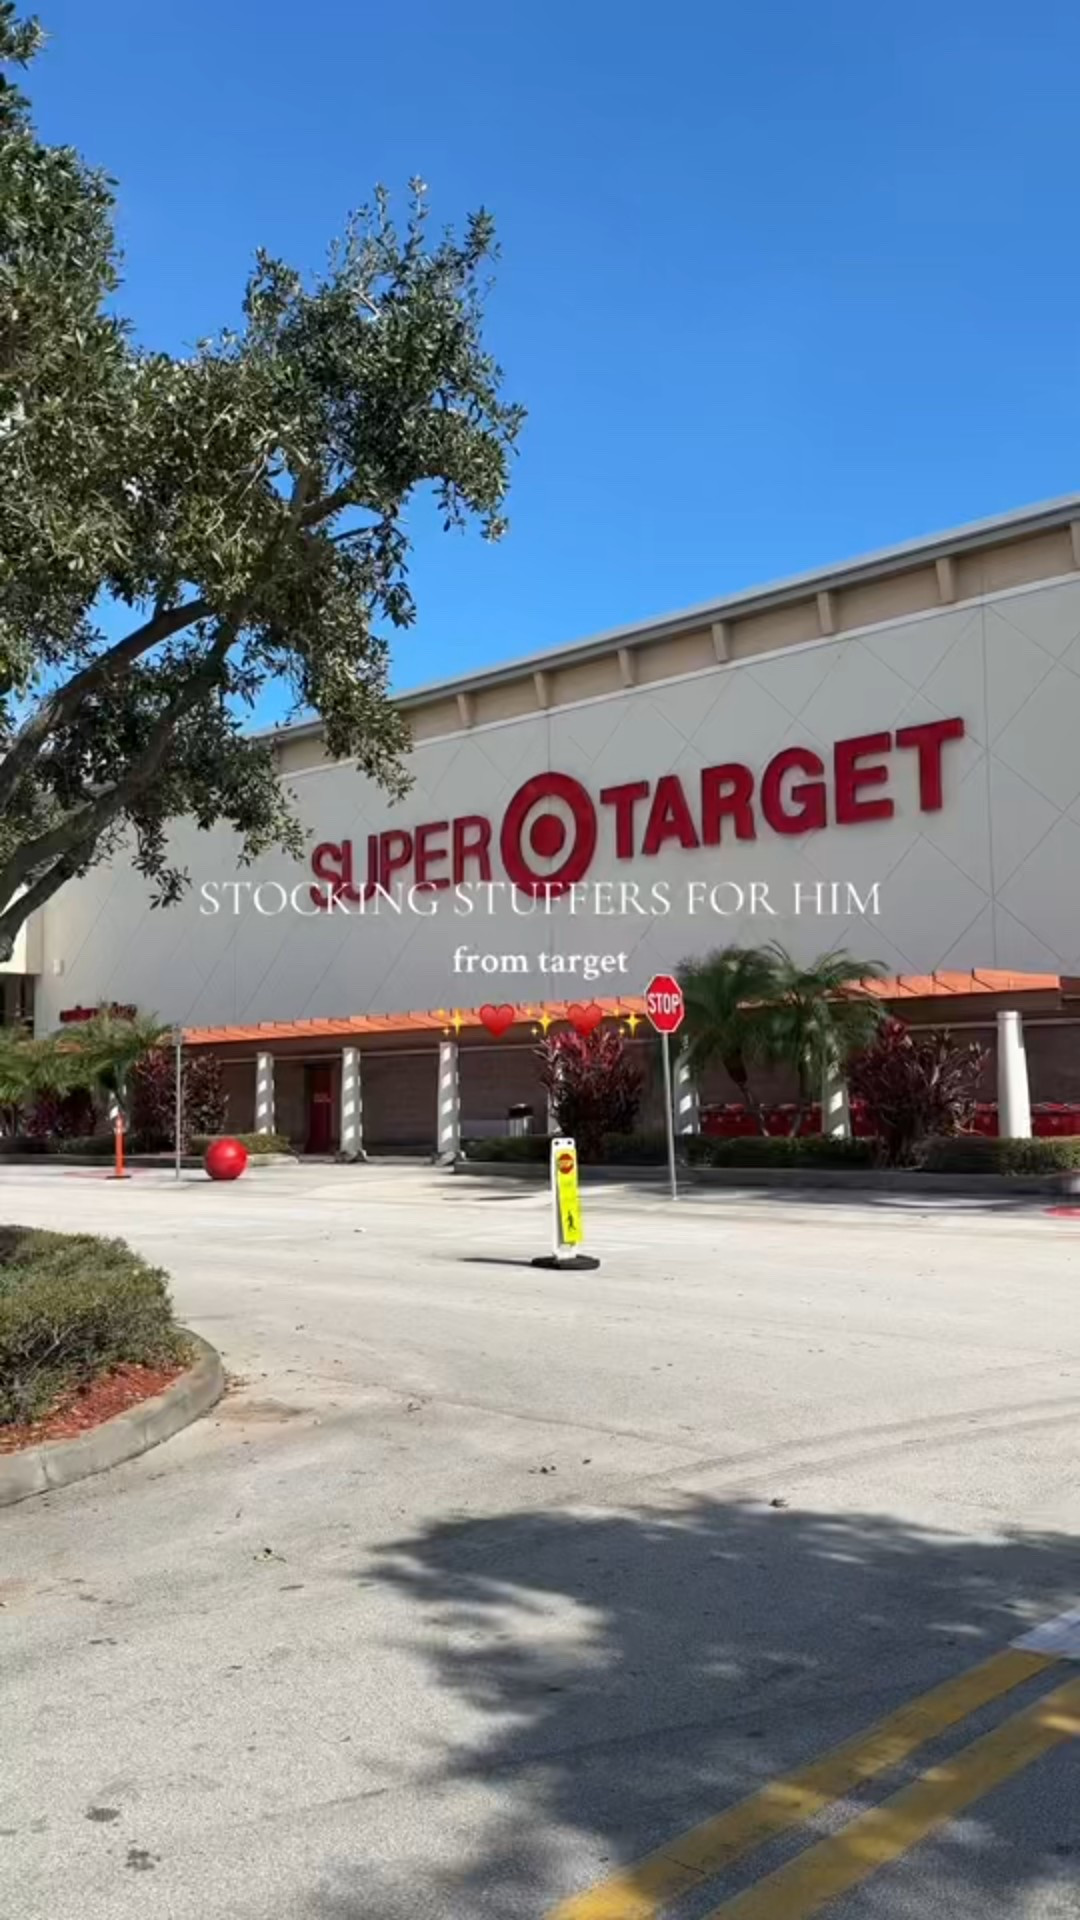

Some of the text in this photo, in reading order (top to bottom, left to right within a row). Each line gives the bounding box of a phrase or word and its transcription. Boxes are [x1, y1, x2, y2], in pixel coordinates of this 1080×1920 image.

[310, 717, 964, 908] SUPER TARGET
[647, 993, 680, 1015] STOP
